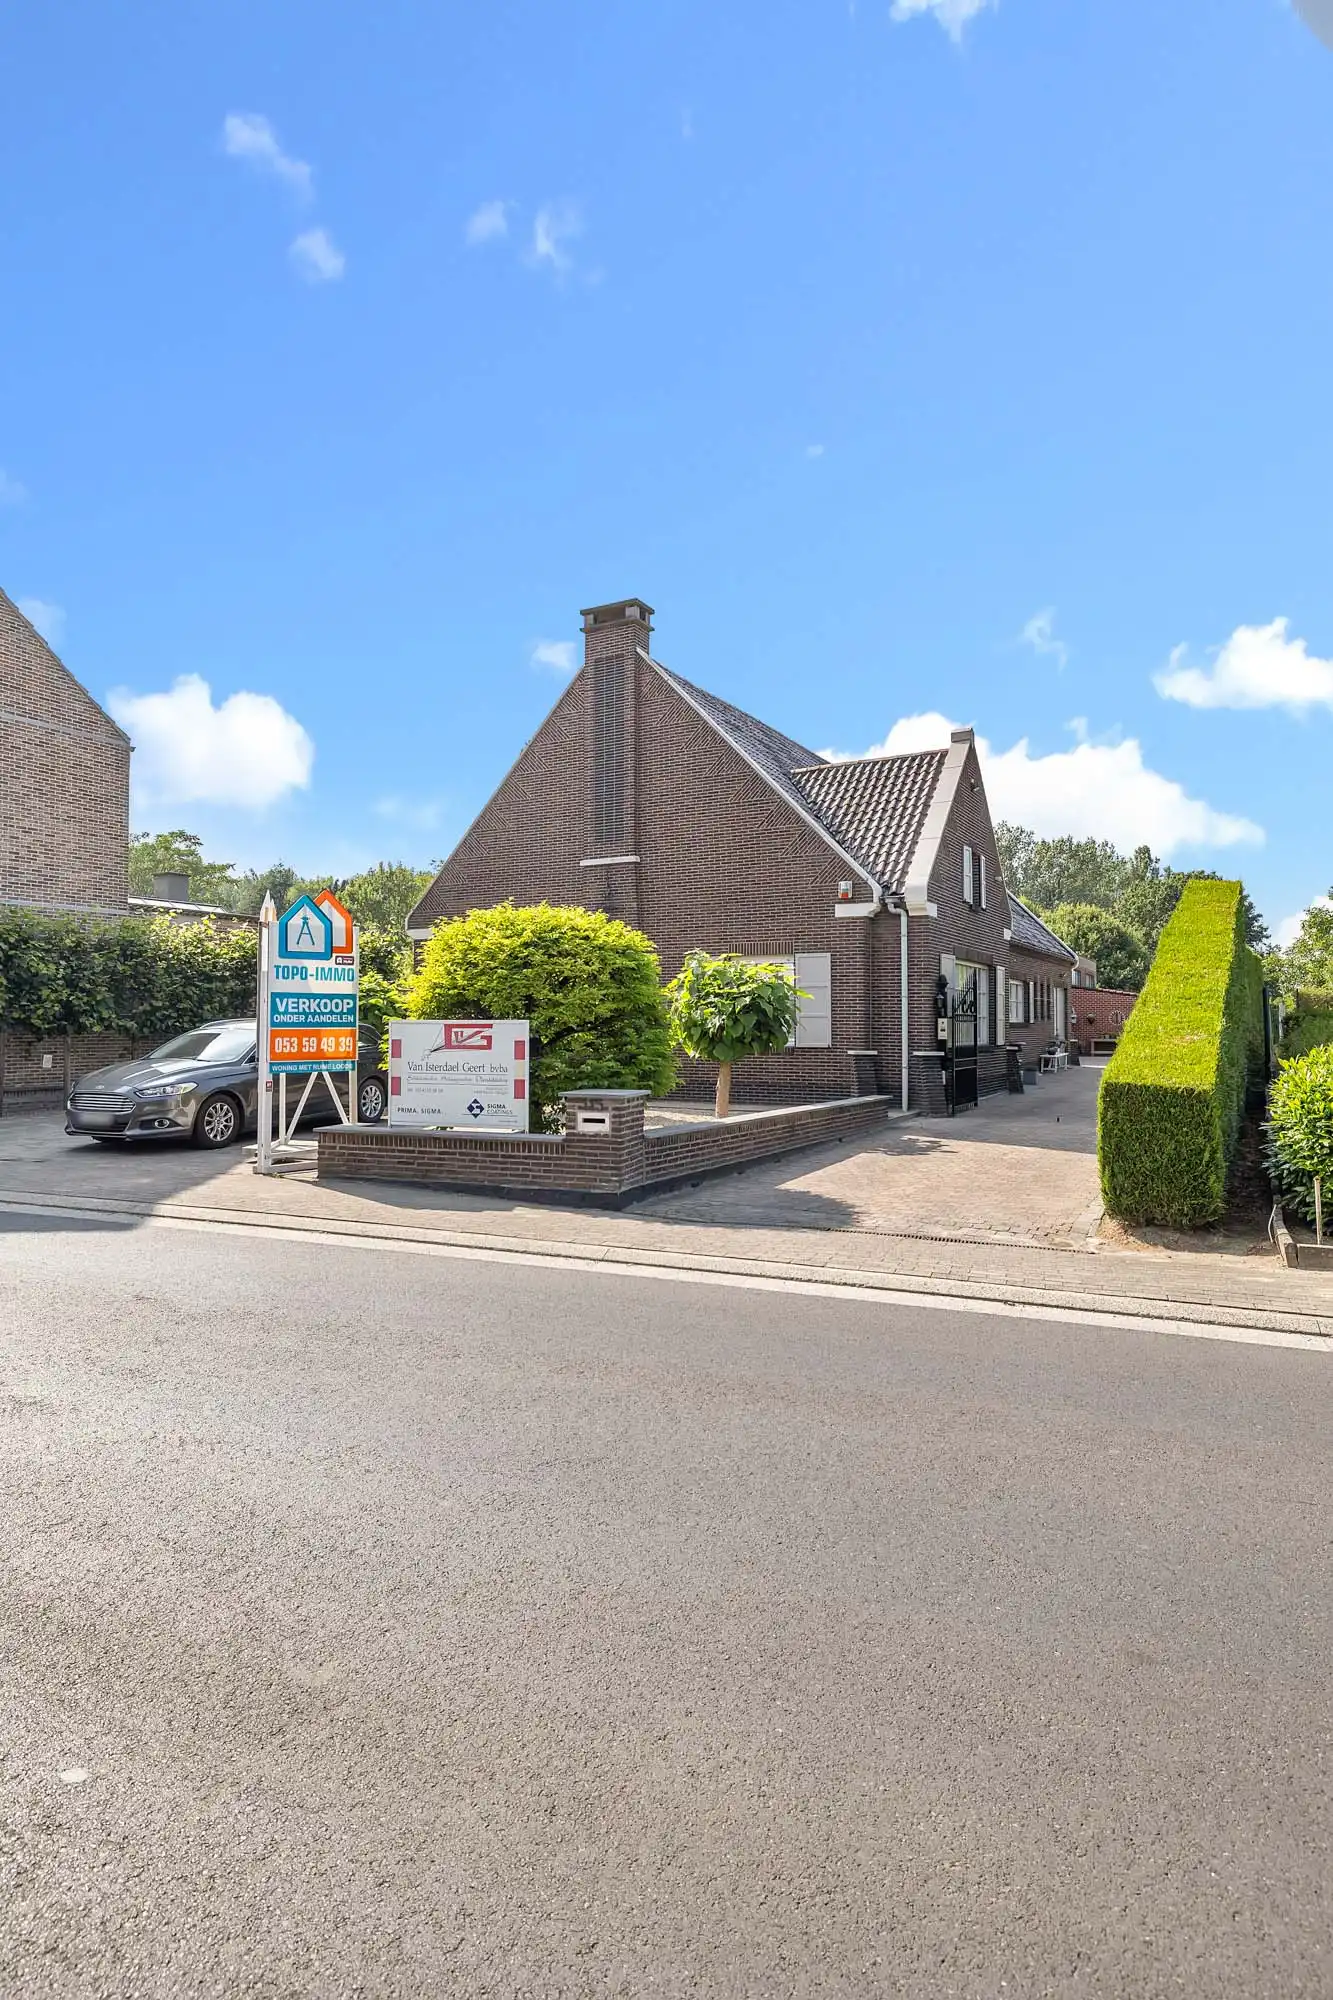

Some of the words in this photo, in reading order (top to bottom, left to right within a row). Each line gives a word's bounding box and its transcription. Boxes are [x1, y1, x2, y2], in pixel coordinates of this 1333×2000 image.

[274, 965, 355, 982] TOPO-IMMO
[275, 997, 354, 1013] VERKOOP
[273, 1014, 305, 1023] ONDER
[307, 1014, 354, 1023] AANDELEN
[275, 1037, 298, 1053] 053
[302, 1037, 317, 1053] 59
[320, 1036, 336, 1053] 49
[338, 1036, 353, 1053] 39
[271, 1064, 298, 1072] WONING
[407, 1061, 423, 1072] Van
[425, 1062, 460, 1073] Isterdael
[462, 1063, 485, 1074] Geert
